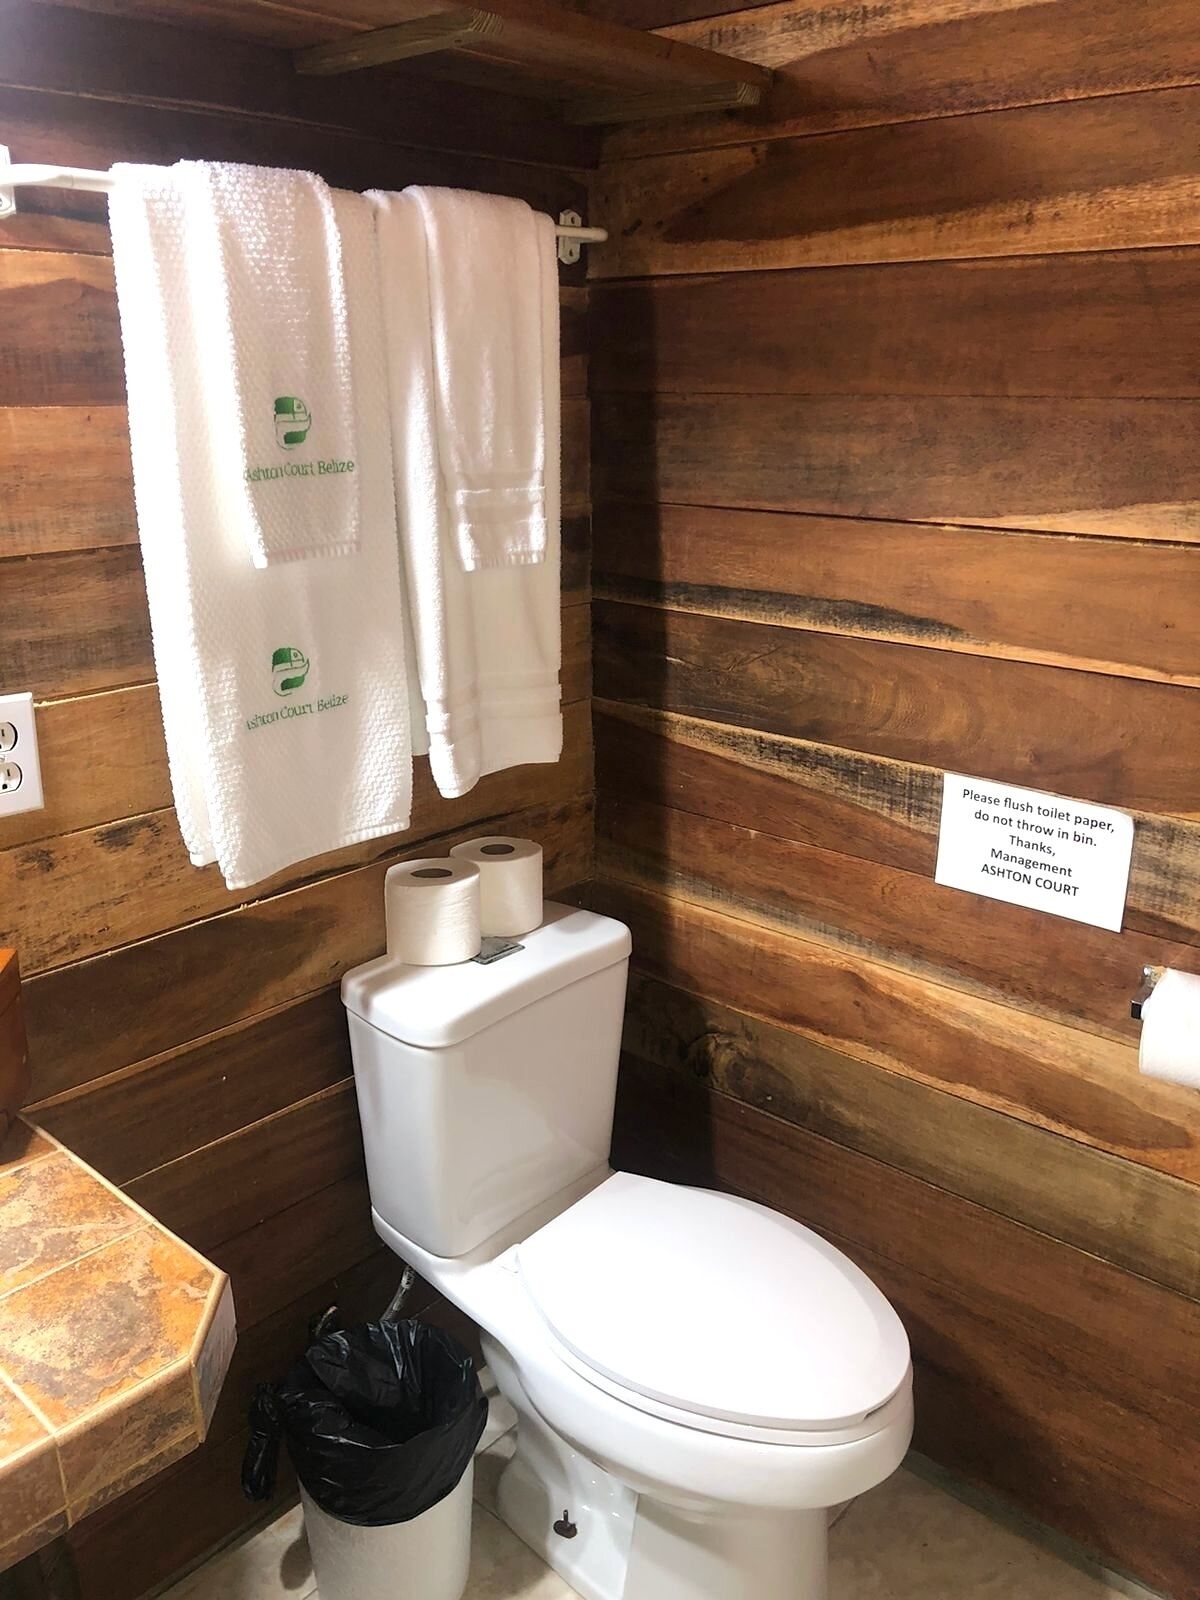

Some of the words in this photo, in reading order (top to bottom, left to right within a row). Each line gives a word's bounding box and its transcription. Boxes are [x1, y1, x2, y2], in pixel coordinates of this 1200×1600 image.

[284, 462, 316, 477] Court
[317, 459, 355, 475] Belize
[280, 704, 313, 719] Court
[317, 694, 350, 712] Belize
[962, 788, 1001, 806] Please
[1003, 797, 1034, 814] flush
[1036, 805, 1071, 822] toilet
[1074, 814, 1116, 834] paper,
[974, 809, 990, 822] do
[992, 815, 1013, 828] not
[1016, 819, 1054, 837] throw
[1057, 827, 1069, 840] in
[1072, 830, 1098, 847] bin.
[1008, 834, 1056, 857] Thanks,
[990, 848, 1073, 878] Management
[980, 863, 1032, 885] ASHTON
[1034, 877, 1080, 897] COURT
